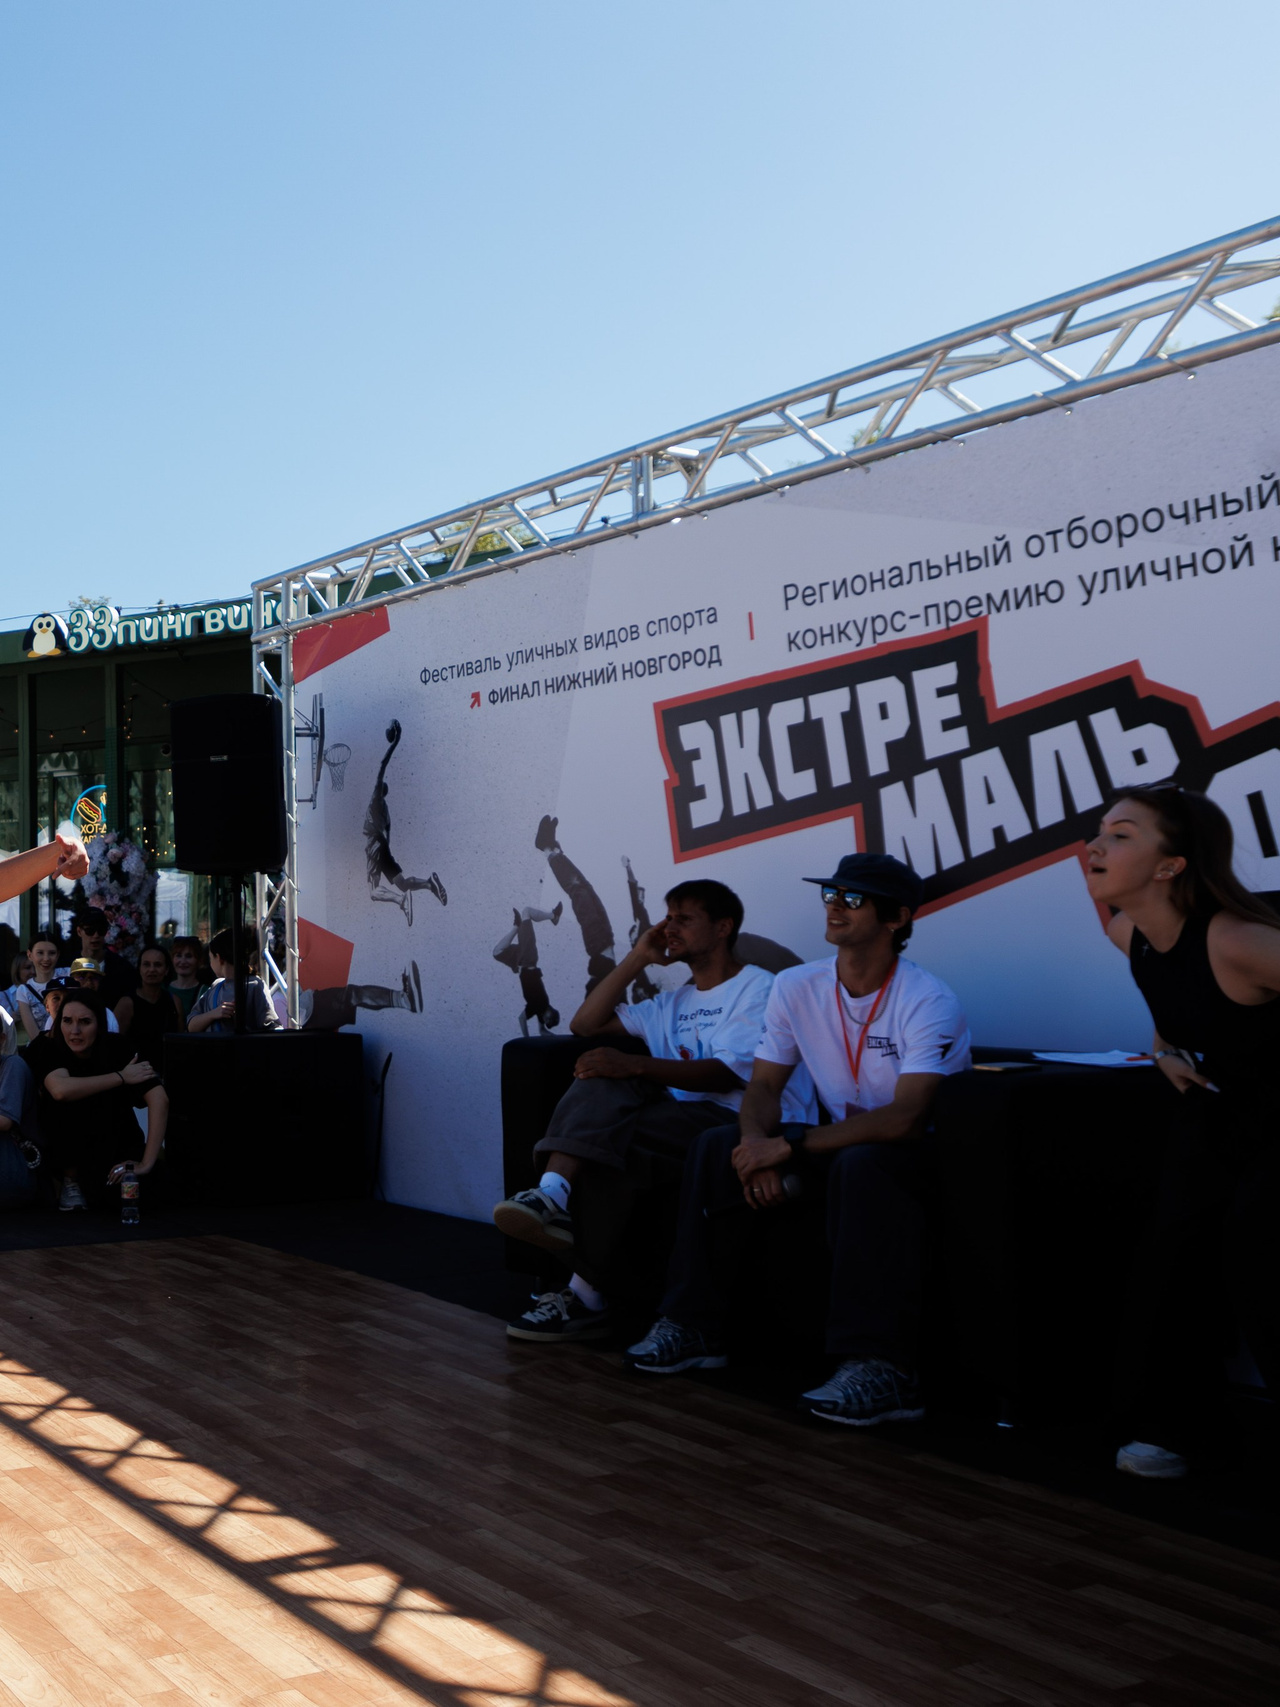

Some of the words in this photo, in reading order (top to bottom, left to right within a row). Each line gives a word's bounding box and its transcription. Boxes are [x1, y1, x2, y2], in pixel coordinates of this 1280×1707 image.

[783, 534, 1012, 610] Региональный
[1025, 471, 1280, 559] отборочный
[787, 578, 1065, 652] конкурс-премию
[1078, 533, 1255, 606] уличной
[68, 605, 115, 651] 33
[419, 655, 502, 685] Фестиваль
[506, 637, 579, 671] уличных
[583, 624, 640, 651] видов
[646, 606, 718, 637] спорта
[487, 680, 542, 706] ФИНАЛ
[544, 662, 618, 696] НИЖНИЙ
[622, 644, 723, 681] НОВГОРОД
[678, 661, 971, 830] ЭКСТРЕ
[879, 707, 1180, 879] МАЛЬ
